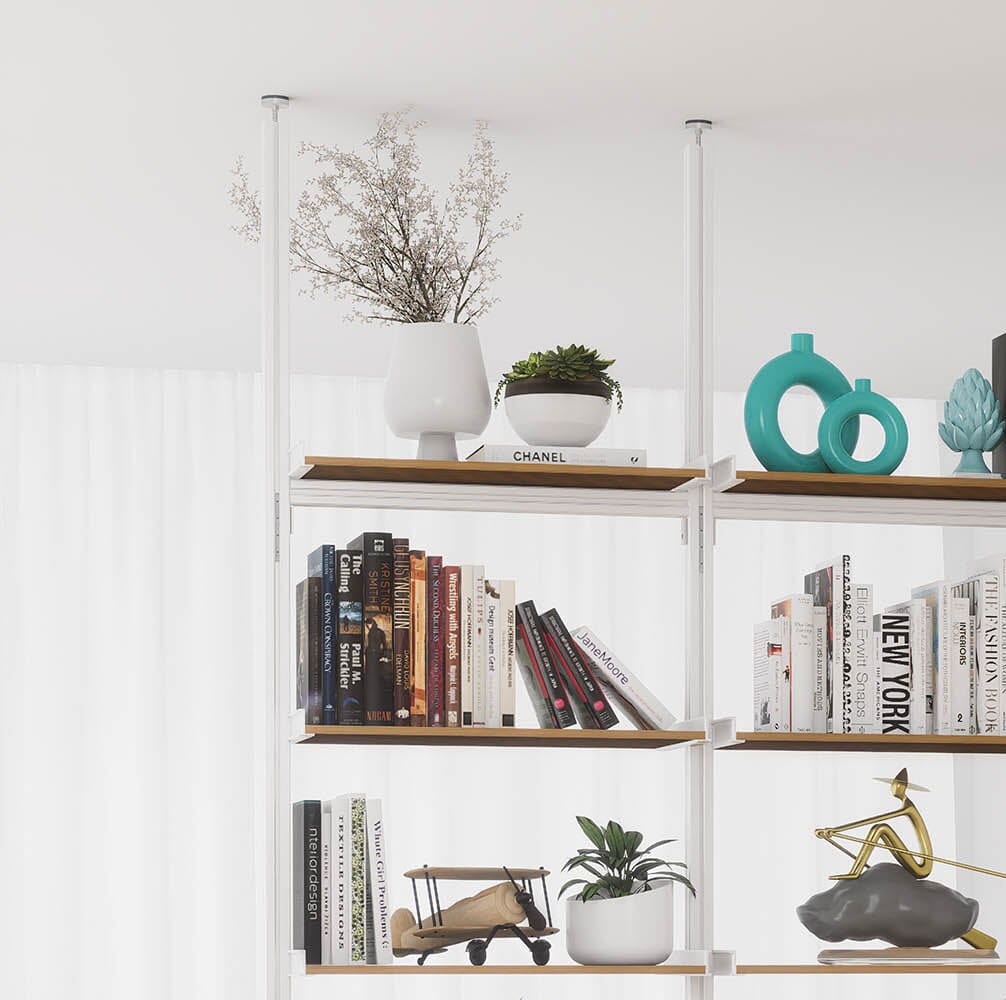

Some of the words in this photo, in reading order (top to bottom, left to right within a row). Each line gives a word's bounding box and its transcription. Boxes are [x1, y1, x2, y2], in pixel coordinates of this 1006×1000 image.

[513, 451, 566, 463] CHANEL
[338, 554, 350, 593] Calling
[352, 554, 362, 575] The
[368, 570, 379, 604] SMITH
[380, 562, 390, 613] KRISTINE
[447, 573, 458, 612] Wrestling
[857, 587, 868, 623] Elliott
[985, 577, 998, 612] THE
[324, 592, 332, 624] CROWN
[447, 614, 458, 632] with
[487, 606, 496, 628] Design
[324, 625, 332, 673] CONSPIRACY
[352, 643, 361, 667] Paul
[447, 632, 458, 660] Angels
[857, 628, 868, 667] Erwitt
[882, 615, 910, 666] NEW
[985, 615, 998, 684] FASHION
[340, 642, 350, 690] Strickler
[352, 671, 361, 685] M.
[855, 672, 868, 718] Snaps
[882, 674, 910, 734] YORK
[985, 689, 998, 734] BOOK
[379, 886, 387, 938] Problems
